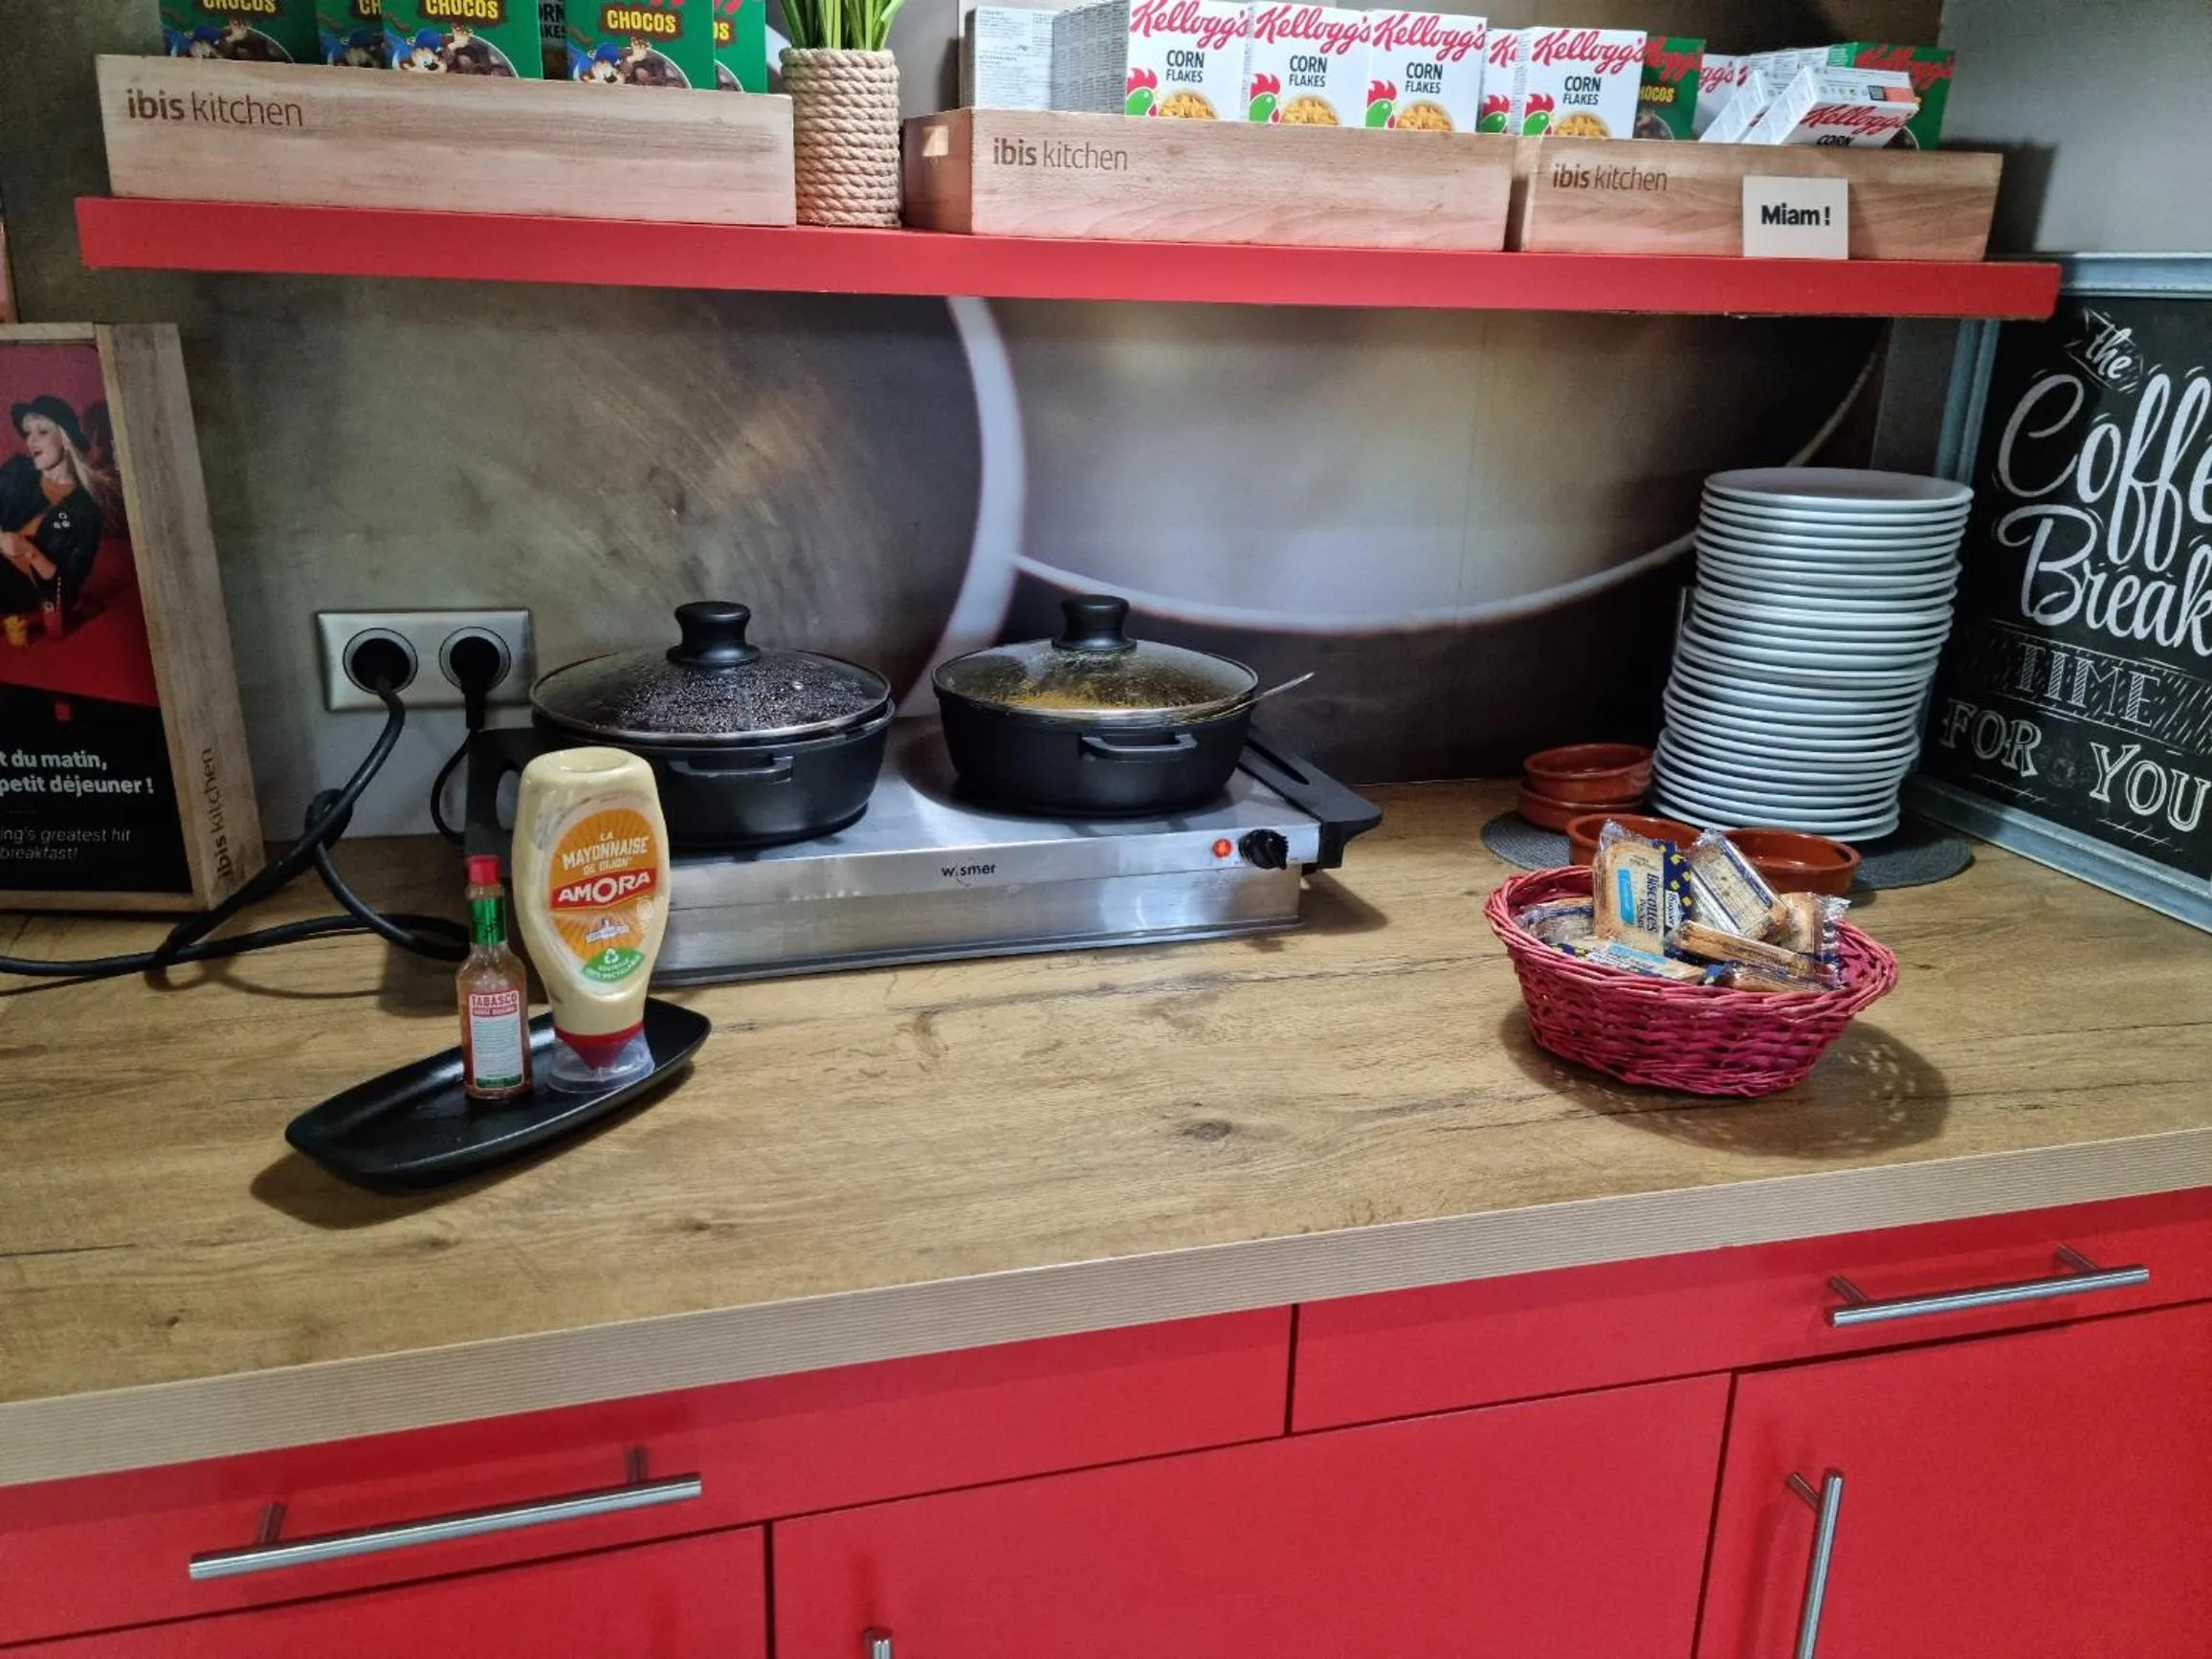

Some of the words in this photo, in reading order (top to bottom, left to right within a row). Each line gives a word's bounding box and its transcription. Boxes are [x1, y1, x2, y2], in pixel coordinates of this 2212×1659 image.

[606, 9, 677, 33] CHOCOS
[1130, 0, 1249, 51] Kellogg's
[1254, 4, 1372, 55] Kellogg's
[1372, 12, 1487, 62] Kellogg's
[1166, 50, 1206, 68] CORN
[1289, 55, 1328, 73] CORN
[1532, 29, 1646, 75] Kellogg's
[1165, 69, 1204, 83] FLAKES
[1288, 74, 1326, 87] FLAKES
[1405, 62, 1444, 80] CORN
[1405, 79, 1442, 94] FLAKES
[1564, 76, 1603, 93] CORN
[1639, 84, 1675, 102] HOCOS
[126, 88, 186, 121] ibis
[191, 91, 303, 127] kitchen
[1562, 93, 1600, 106] FLAKES
[993, 137, 1037, 166] ibis
[1043, 140, 1128, 171] kitchen
[1552, 164, 1589, 188] ibis
[1594, 165, 1668, 190] kitchen
[1760, 202, 1820, 226] Miam
[2085, 325, 2133, 380] the
[1997, 373, 2212, 572] Coffe
[1997, 503, 2212, 657] Break
[2016, 642, 2160, 728] TIME
[11, 749, 37, 767] du
[41, 750, 107, 771] matin,
[1938, 697, 2042, 778] FOR
[2089, 741, 2212, 832] YOU
[0, 774, 46, 797] petit
[50, 774, 143, 797] déjeuner
[202, 747, 225, 833] kitchen
[41, 828, 107, 845] greatest
[112, 828, 131, 842] hit
[600, 830, 614, 842] LA
[215, 834, 232, 880] ibis
[562, 835, 650, 872] MAYONNAISE
[558, 872, 652, 903] AMORA
[472, 993, 518, 1007] TABASCO
